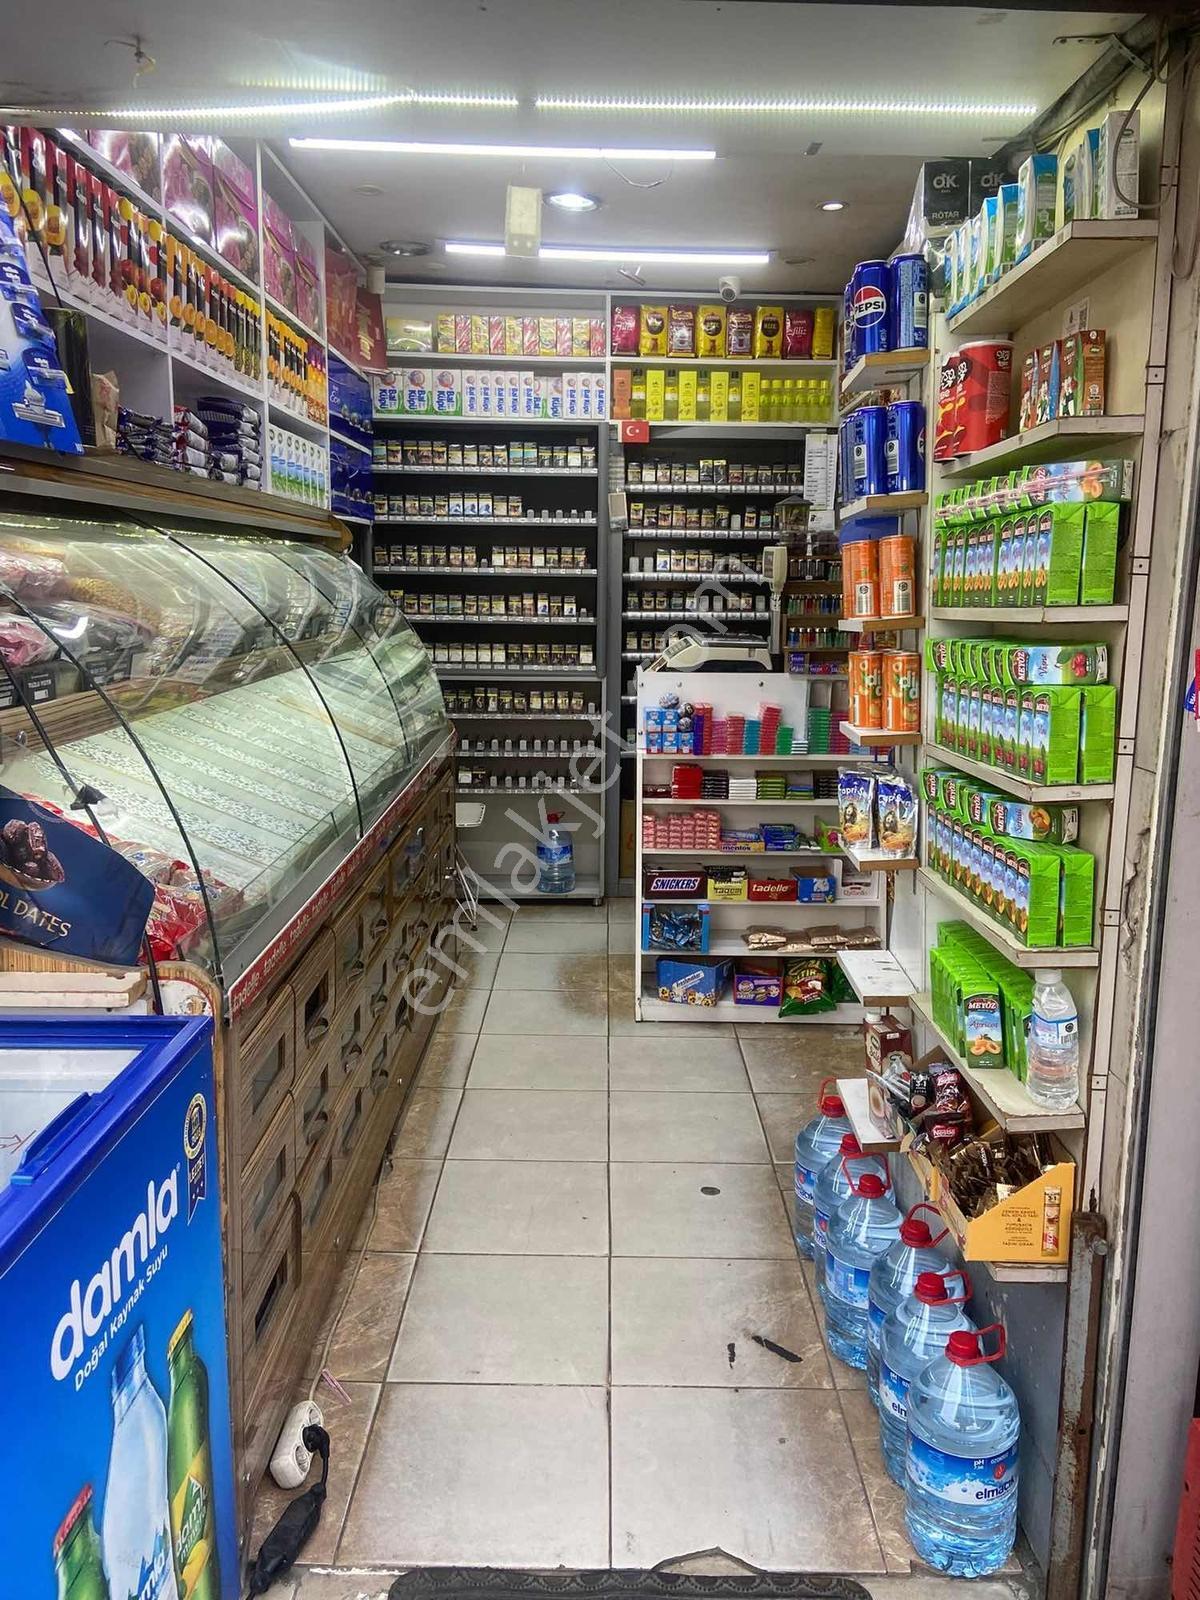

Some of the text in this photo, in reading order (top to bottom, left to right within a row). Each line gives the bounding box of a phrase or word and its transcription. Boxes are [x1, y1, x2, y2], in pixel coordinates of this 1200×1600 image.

[653, 878, 698, 890] SNICKERS
[14, 901, 72, 938] DATES
[968, 1000, 996, 1010] MEYÖZ
[968, 1020, 998, 1029] Apricot
[50, 1167, 179, 1381] damla
[74, 1246, 168, 1392] Doğal Kaynak Suyu
